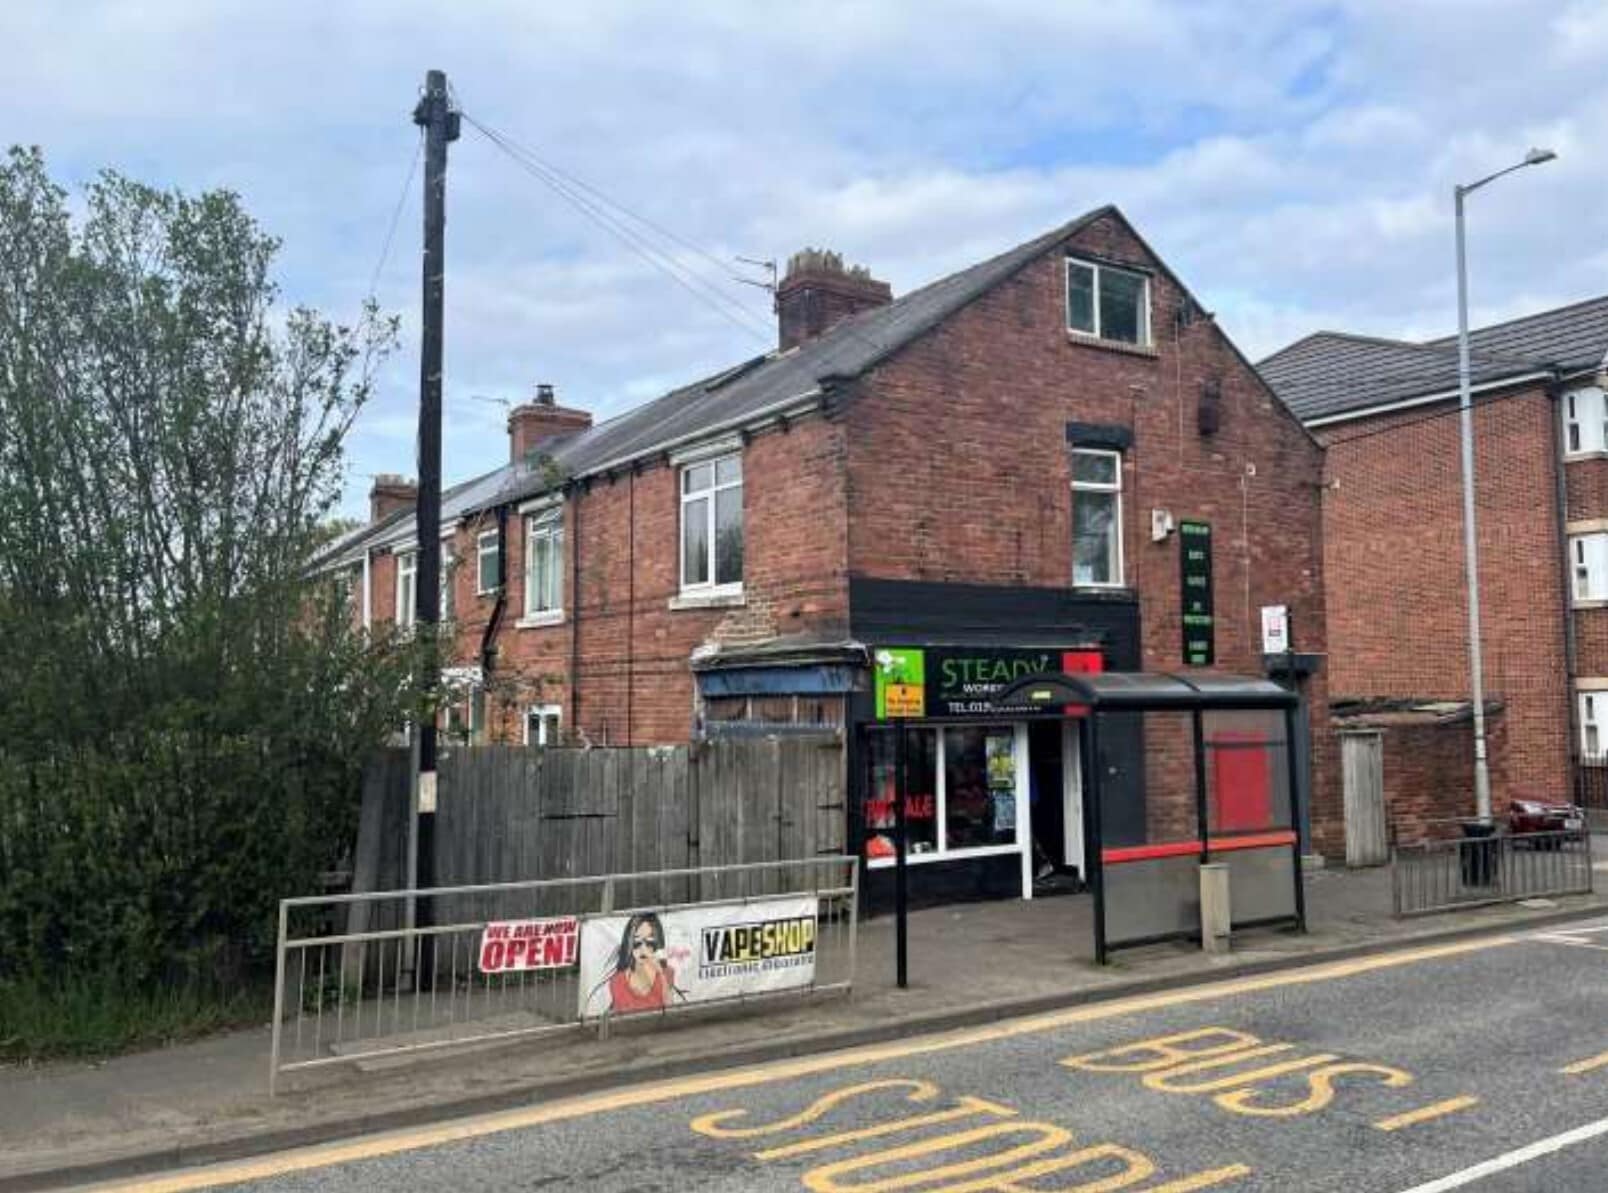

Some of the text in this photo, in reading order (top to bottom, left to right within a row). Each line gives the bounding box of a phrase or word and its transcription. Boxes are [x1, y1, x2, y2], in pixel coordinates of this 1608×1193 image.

[942, 656, 1046, 688] STEADY
[487, 920, 577, 939] WE ARE NOW
[482, 934, 576, 971] OPEN!
[1057, 1026, 1414, 1116] BUS
[690, 1078, 1155, 1193] STOP
